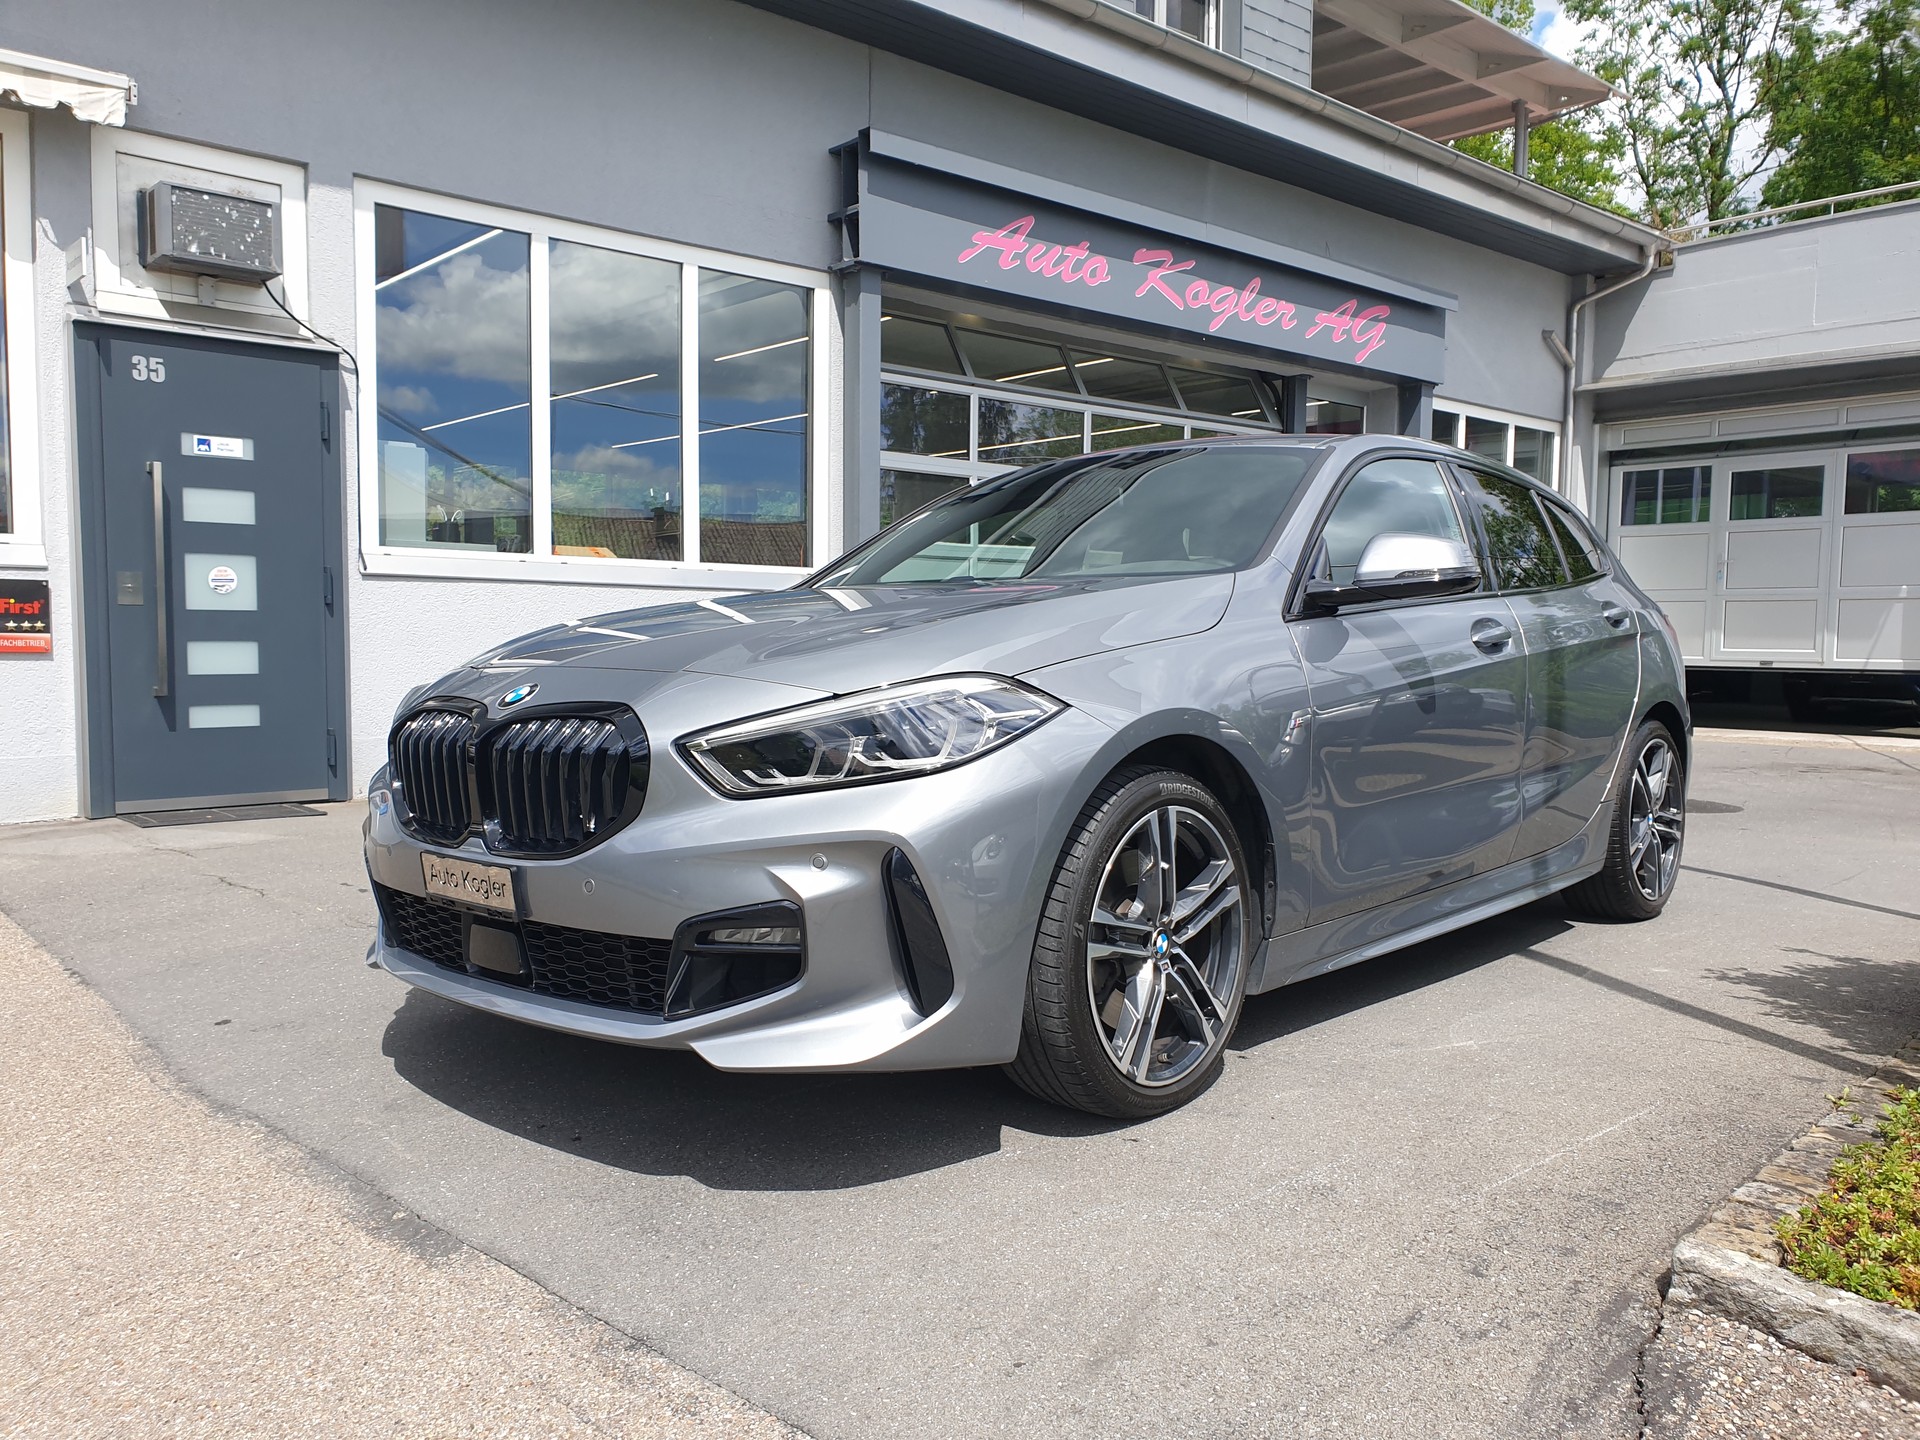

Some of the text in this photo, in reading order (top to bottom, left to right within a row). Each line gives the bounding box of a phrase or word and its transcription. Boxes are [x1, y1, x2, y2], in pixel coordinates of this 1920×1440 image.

[958, 214, 1391, 364] Auto Kogler AG
[132, 355, 165, 382] 35
[0, 598, 41, 614] First
[0, 639, 45, 647] FACHBETRIEB
[1159, 783, 1215, 808] BRIDGESTONE
[430, 863, 506, 899] Auto Kogler
